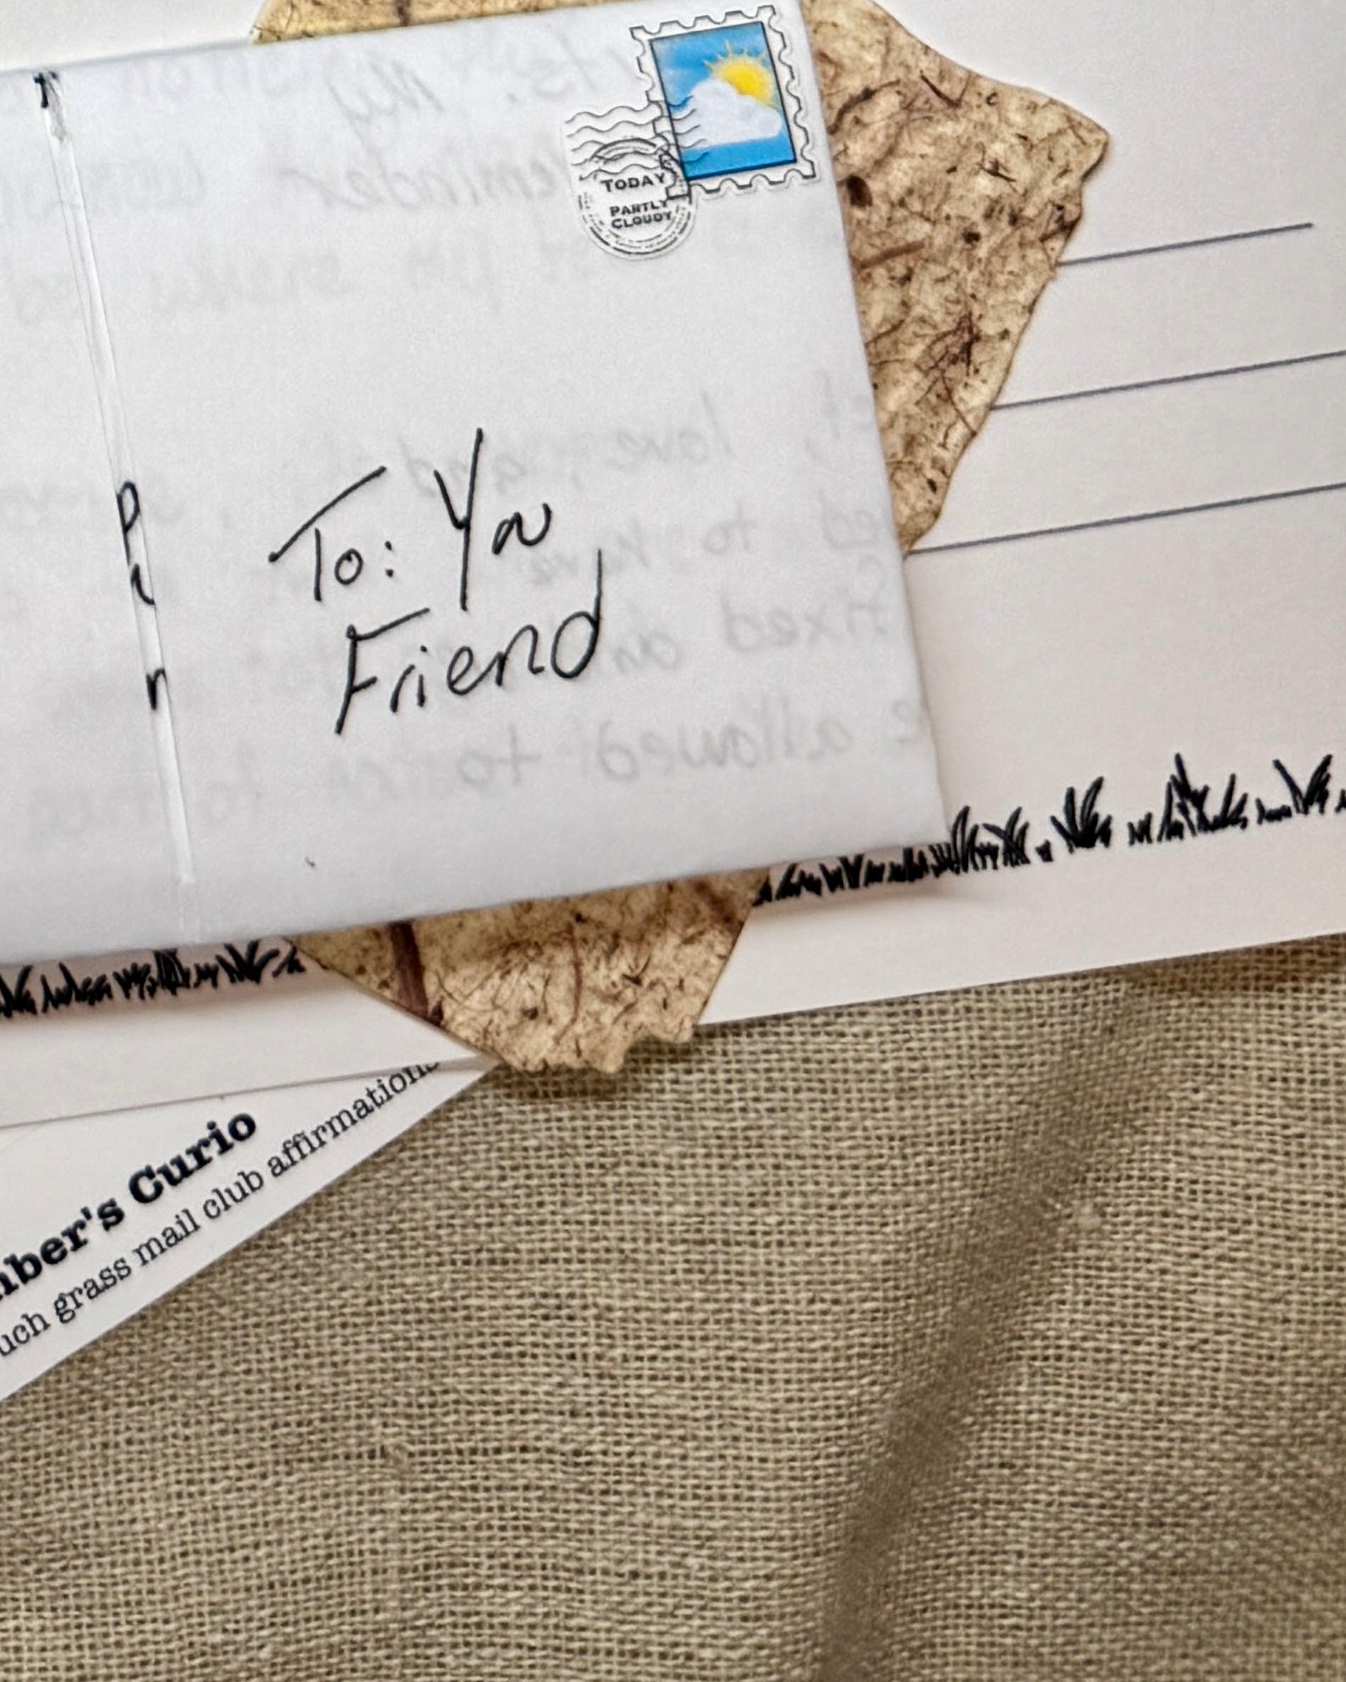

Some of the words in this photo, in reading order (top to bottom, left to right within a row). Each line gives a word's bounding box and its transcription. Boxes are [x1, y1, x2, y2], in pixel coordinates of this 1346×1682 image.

[600, 172, 666, 193] TODAY
[609, 199, 669, 217] PARTLY
[610, 210, 672, 230] CLOUDY
[268, 464, 396, 602] To:
[334, 547, 604, 736] Friend
[127, 1111, 258, 1206] Curio
[51, 1261, 133, 1326] grass
[131, 1208, 201, 1269] mail
[201, 1170, 265, 1221] club
